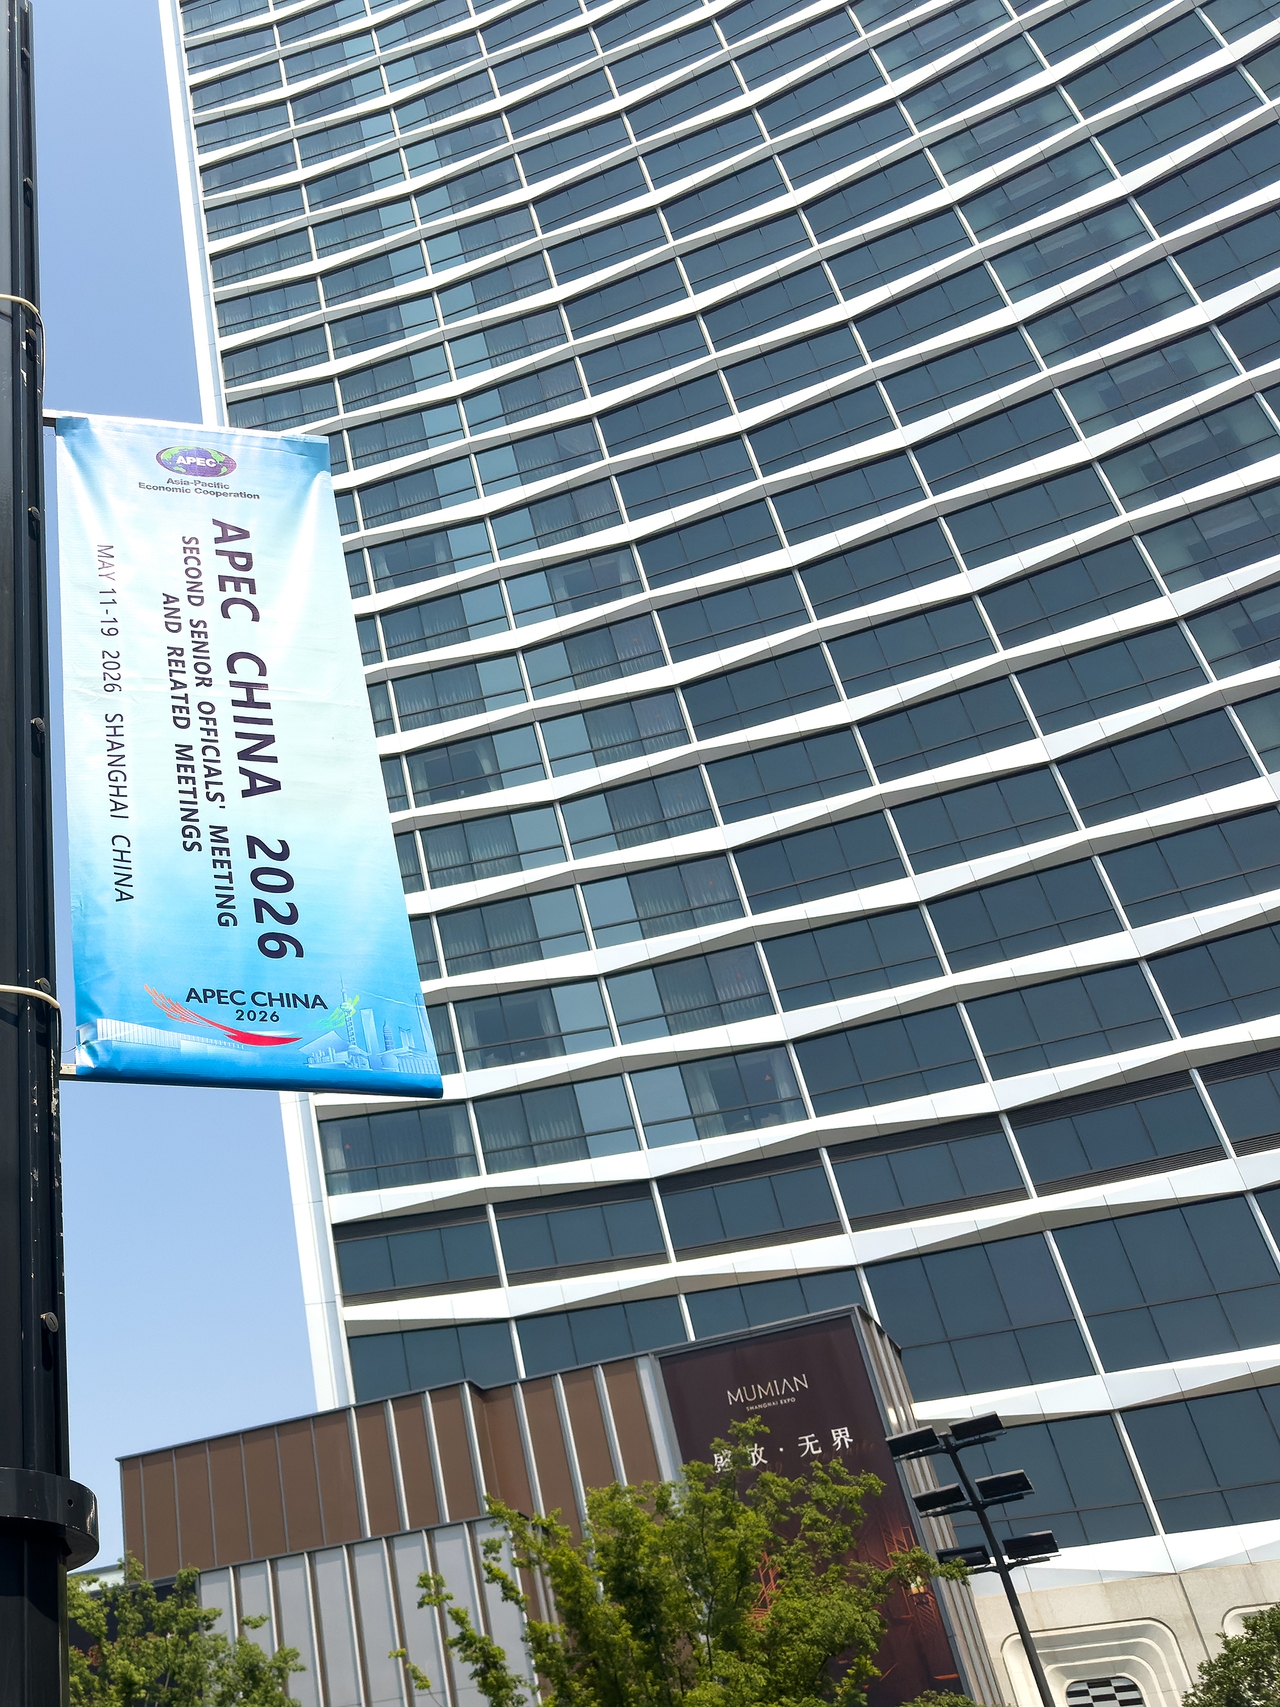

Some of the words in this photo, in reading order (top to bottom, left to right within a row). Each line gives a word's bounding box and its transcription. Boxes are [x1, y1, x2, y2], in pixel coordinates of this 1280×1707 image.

[166, 477, 230, 490] Asia-Pacific
[176, 455, 217, 468] APEC
[138, 481, 191, 494] Economic
[194, 487, 260, 500] Cooperation
[97, 545, 116, 581] MAY
[182, 536, 204, 607] SECOND
[212, 518, 260, 622] APEC
[99, 588, 119, 636] 11-19
[162, 593, 182, 633] AND
[102, 650, 122, 692] 2026
[189, 619, 212, 687] SENIOR
[167, 646, 190, 729] RELATED
[226, 652, 281, 798] CHINA
[105, 714, 129, 818] SHANGHAI
[197, 701, 225, 809] OFFICIALS'
[175, 744, 202, 852] MEETINGS
[111, 835, 134, 902] CHINA
[209, 825, 238, 927] MEETING
[246, 835, 304, 959] 2026
[186, 988, 246, 1005] APEC
[250, 991, 329, 1010] CHINA
[236, 1009, 279, 1022] 2026
[726, 1373, 809, 1406] MUMIAN
[745, 1400, 779, 1412] SHANGHAI
[779, 1396, 796, 1407] EXPO
